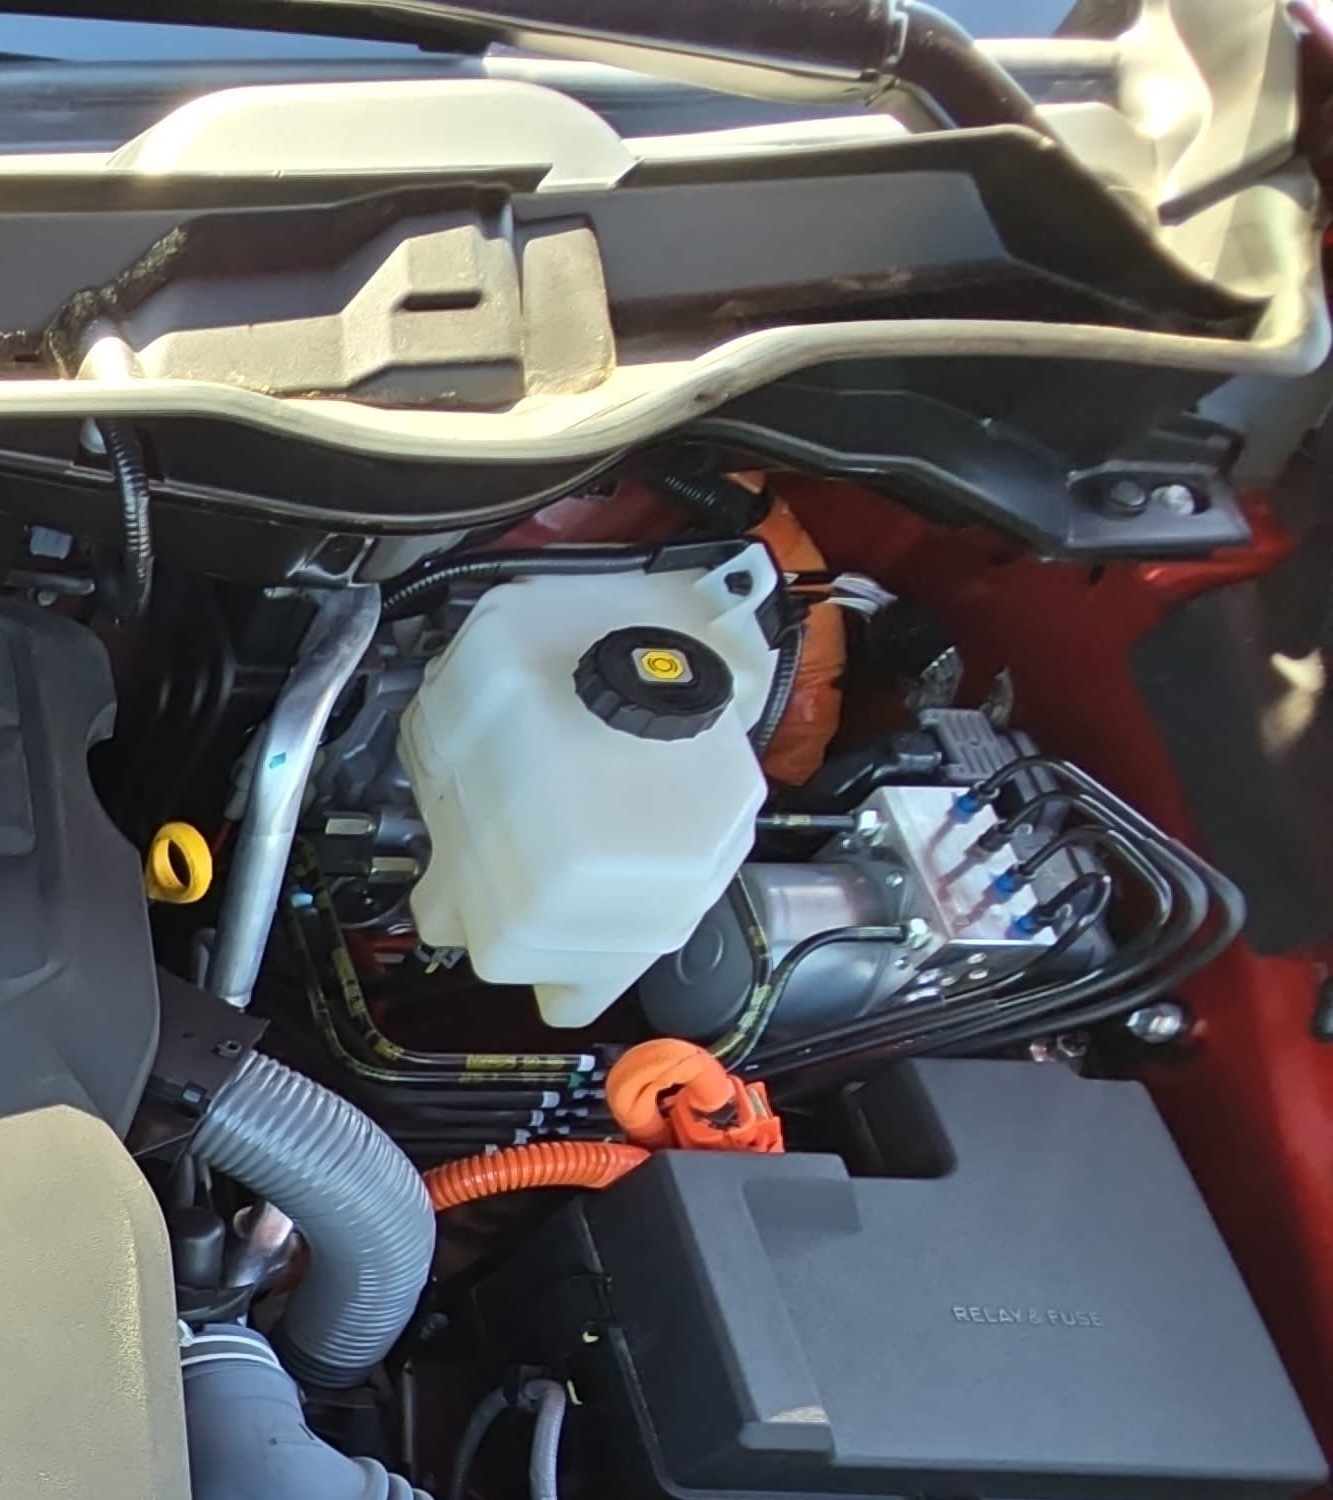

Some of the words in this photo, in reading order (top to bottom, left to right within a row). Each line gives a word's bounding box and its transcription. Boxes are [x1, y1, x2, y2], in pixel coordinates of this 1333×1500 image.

[951, 1305, 1022, 1324] RELAY
[1028, 1308, 1041, 1325] &
[1046, 1308, 1105, 1328] FUSE
